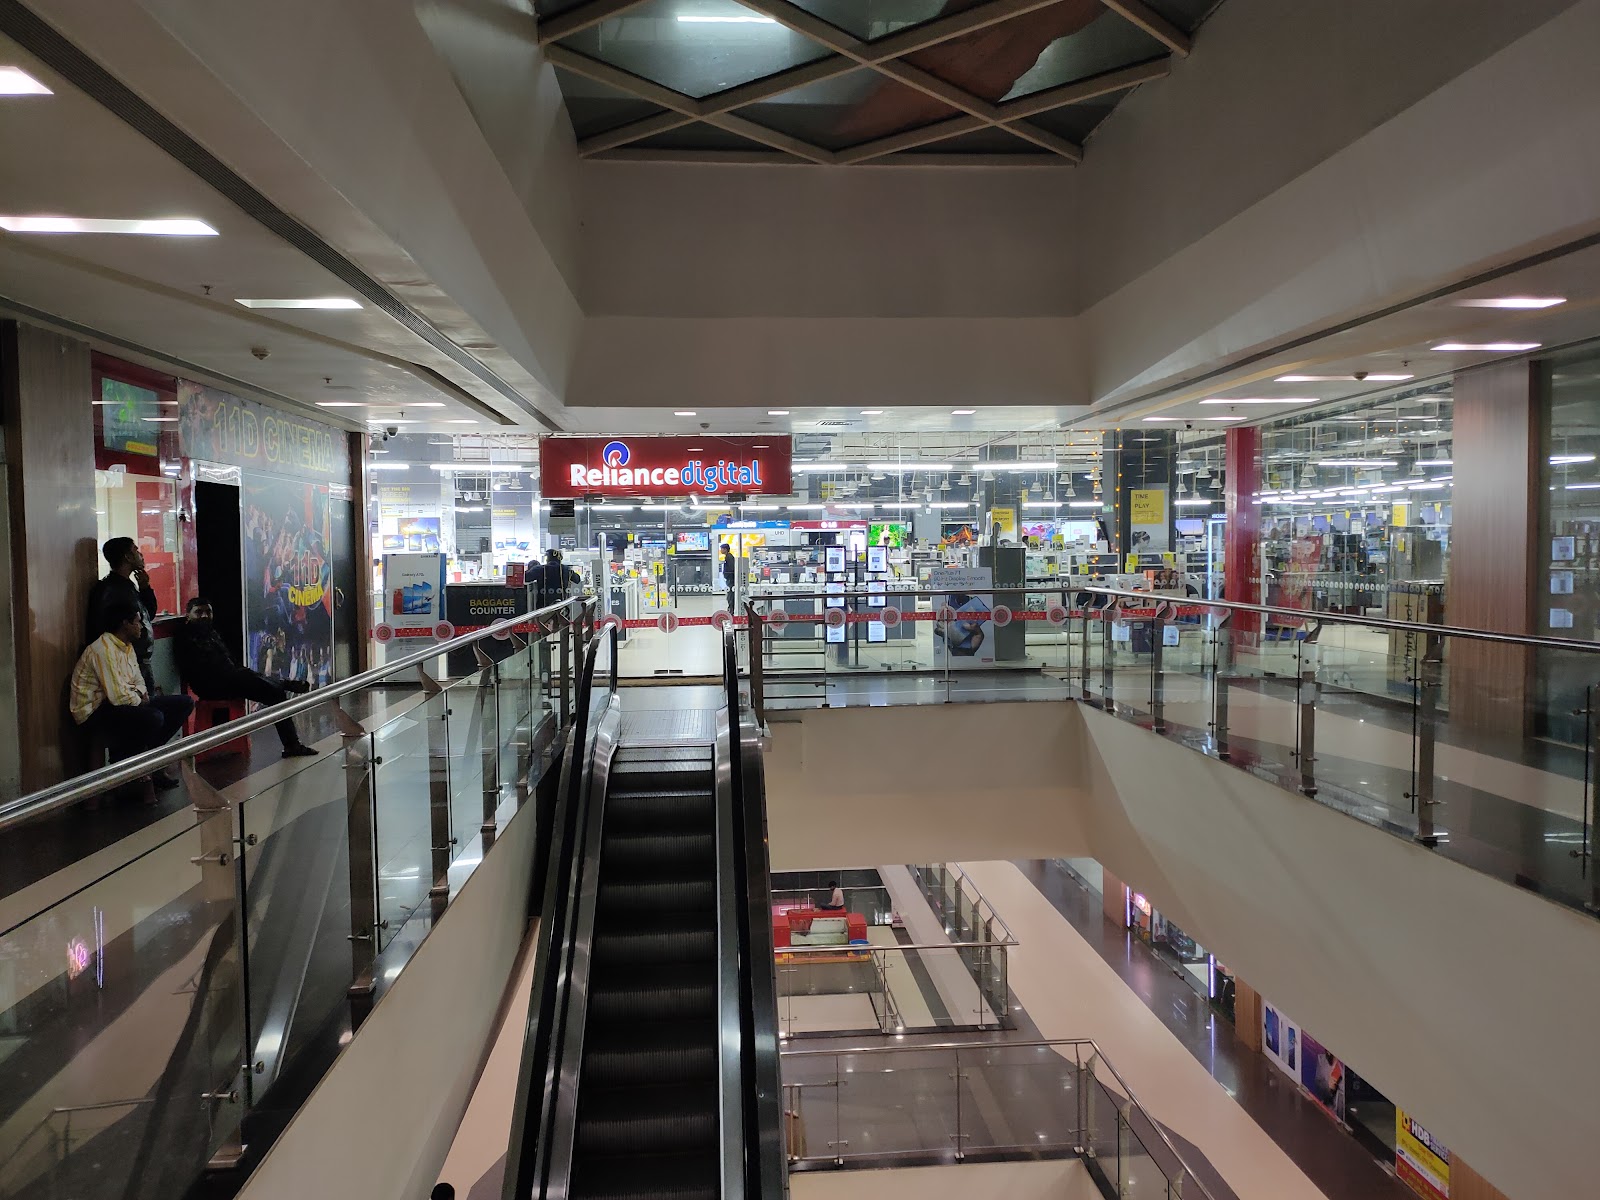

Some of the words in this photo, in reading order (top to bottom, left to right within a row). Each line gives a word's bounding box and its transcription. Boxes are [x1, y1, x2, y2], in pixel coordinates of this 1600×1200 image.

[469, 598, 516, 607] BAGGAGE
[469, 606, 516, 615] COUNTER
[1411, 1119, 1430, 1148] HDB
